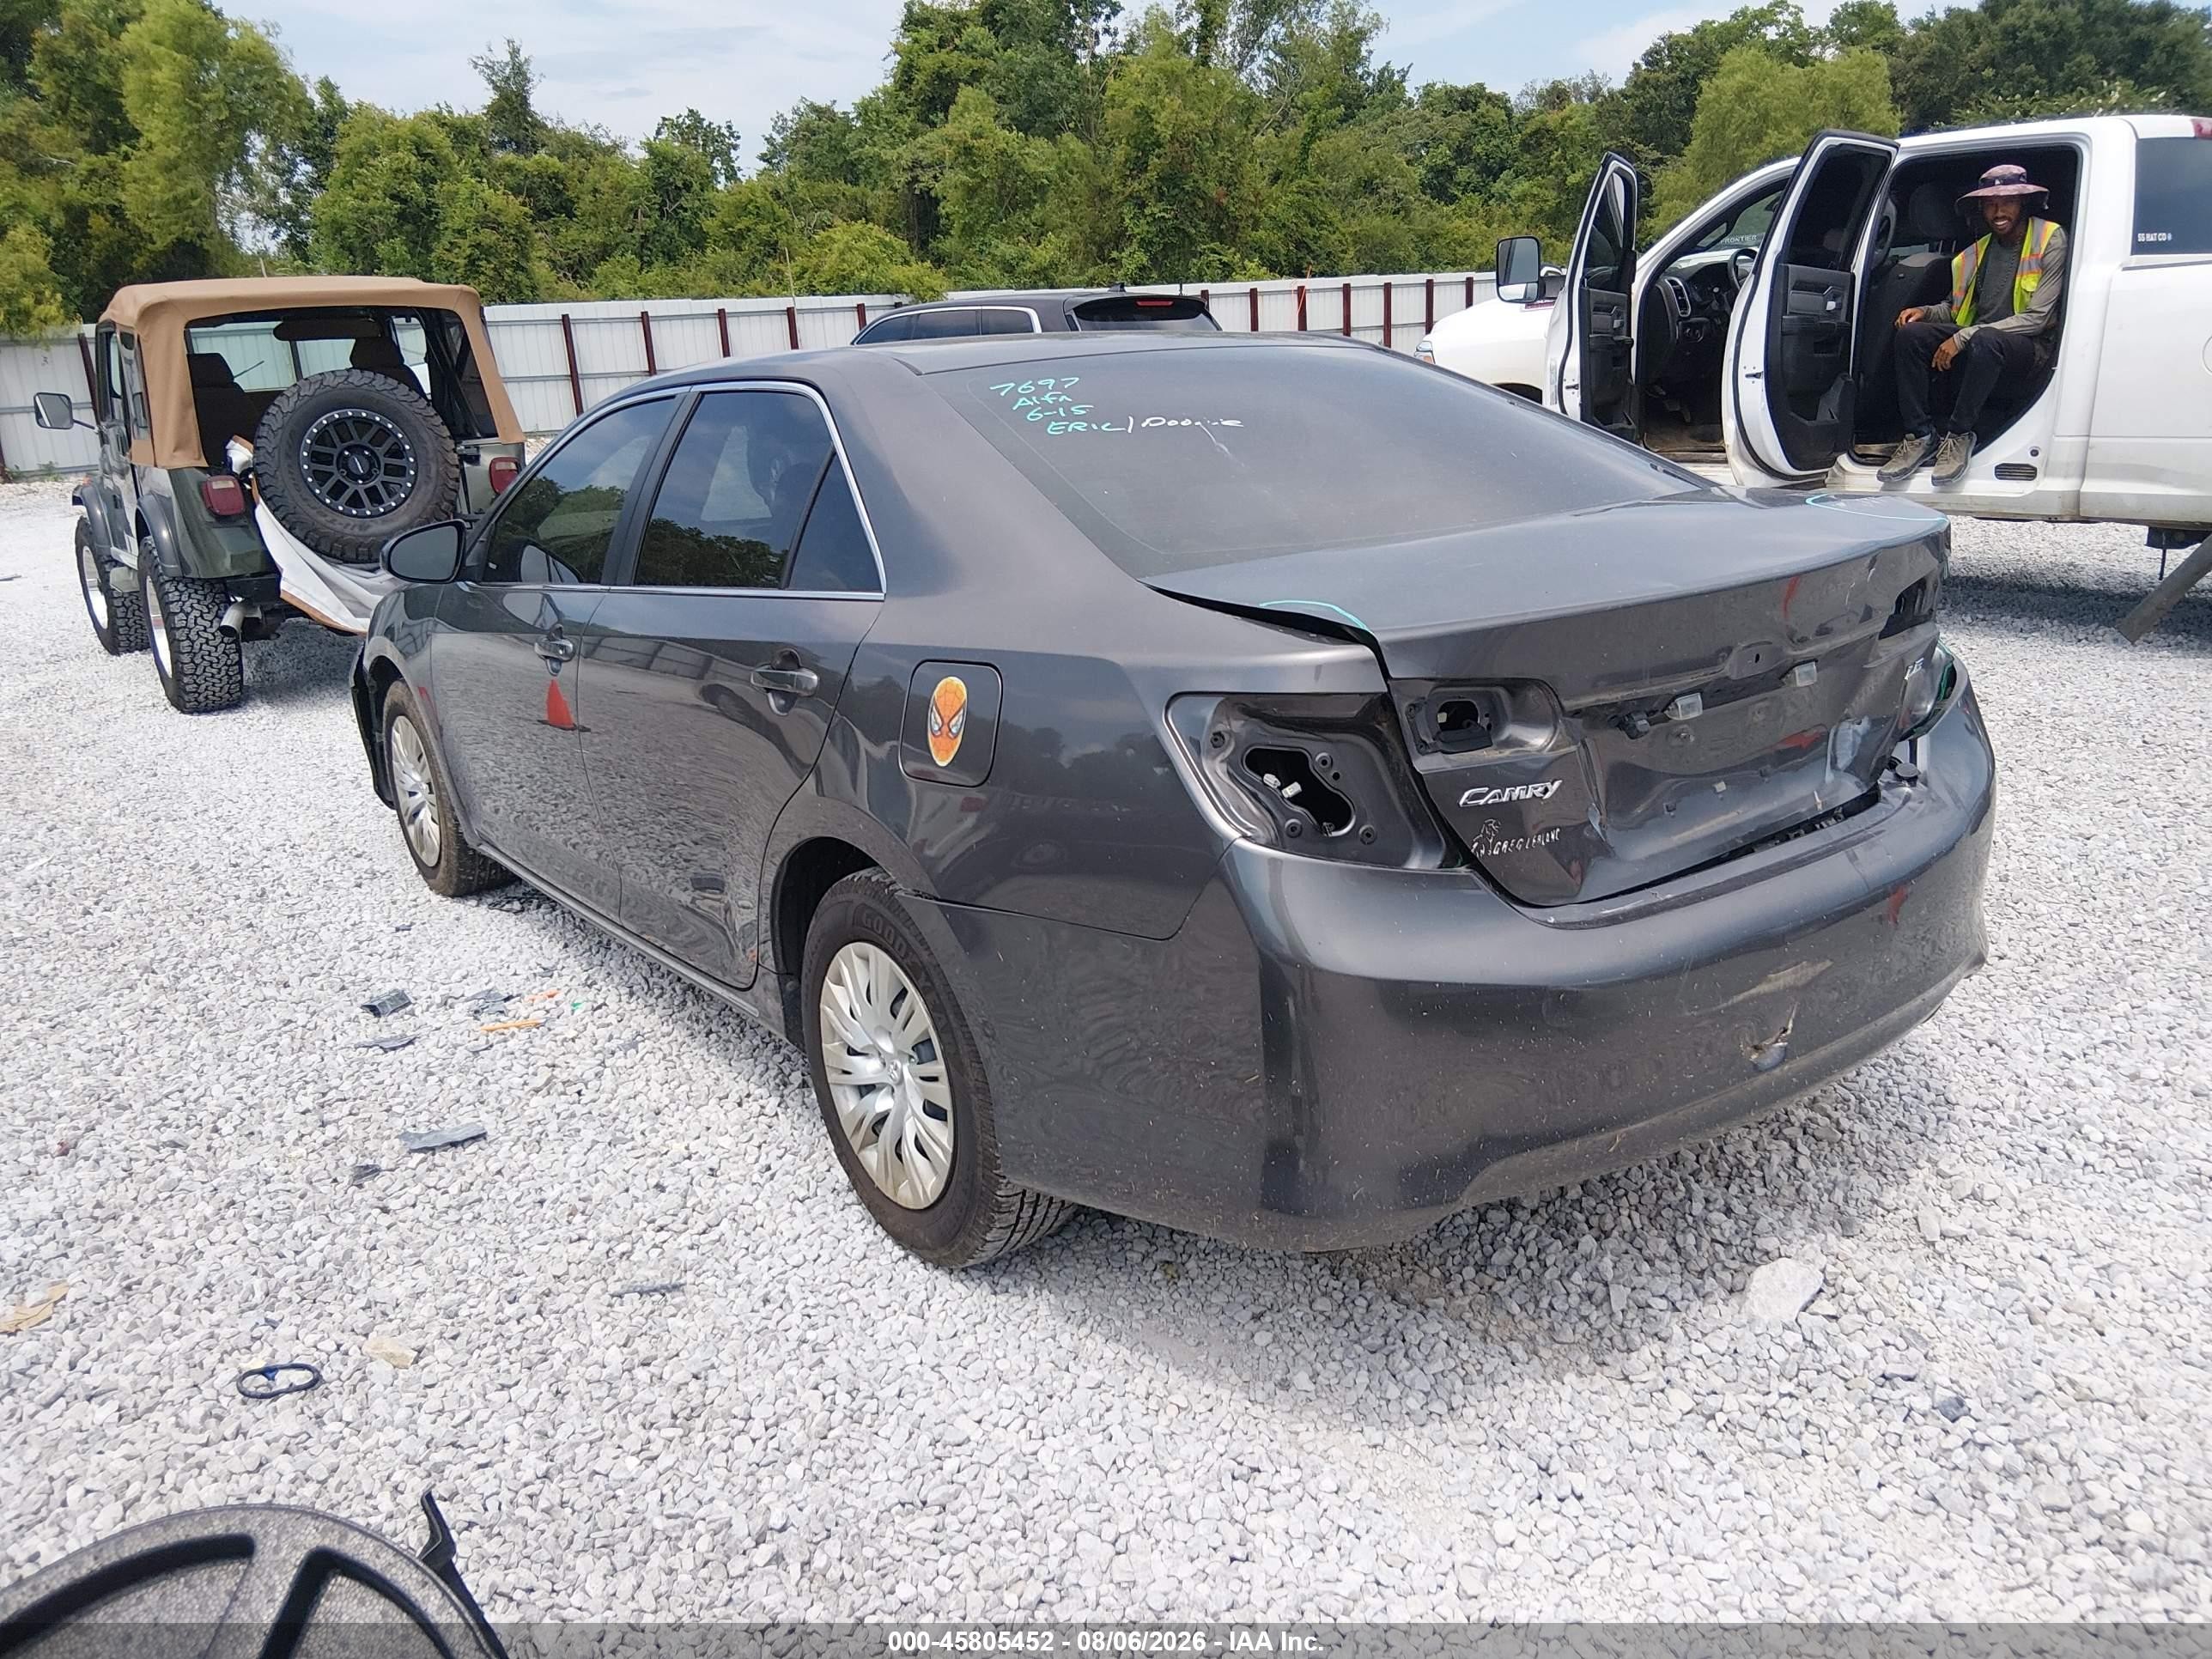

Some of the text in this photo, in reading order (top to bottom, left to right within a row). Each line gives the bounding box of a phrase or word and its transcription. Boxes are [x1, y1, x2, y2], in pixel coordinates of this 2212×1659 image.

[1720, 234, 1757, 244] FRONTIER
[989, 377, 1079, 396] 7697
[1027, 404, 1094, 421] 6-15
[1459, 780, 1563, 807] CAMRY
